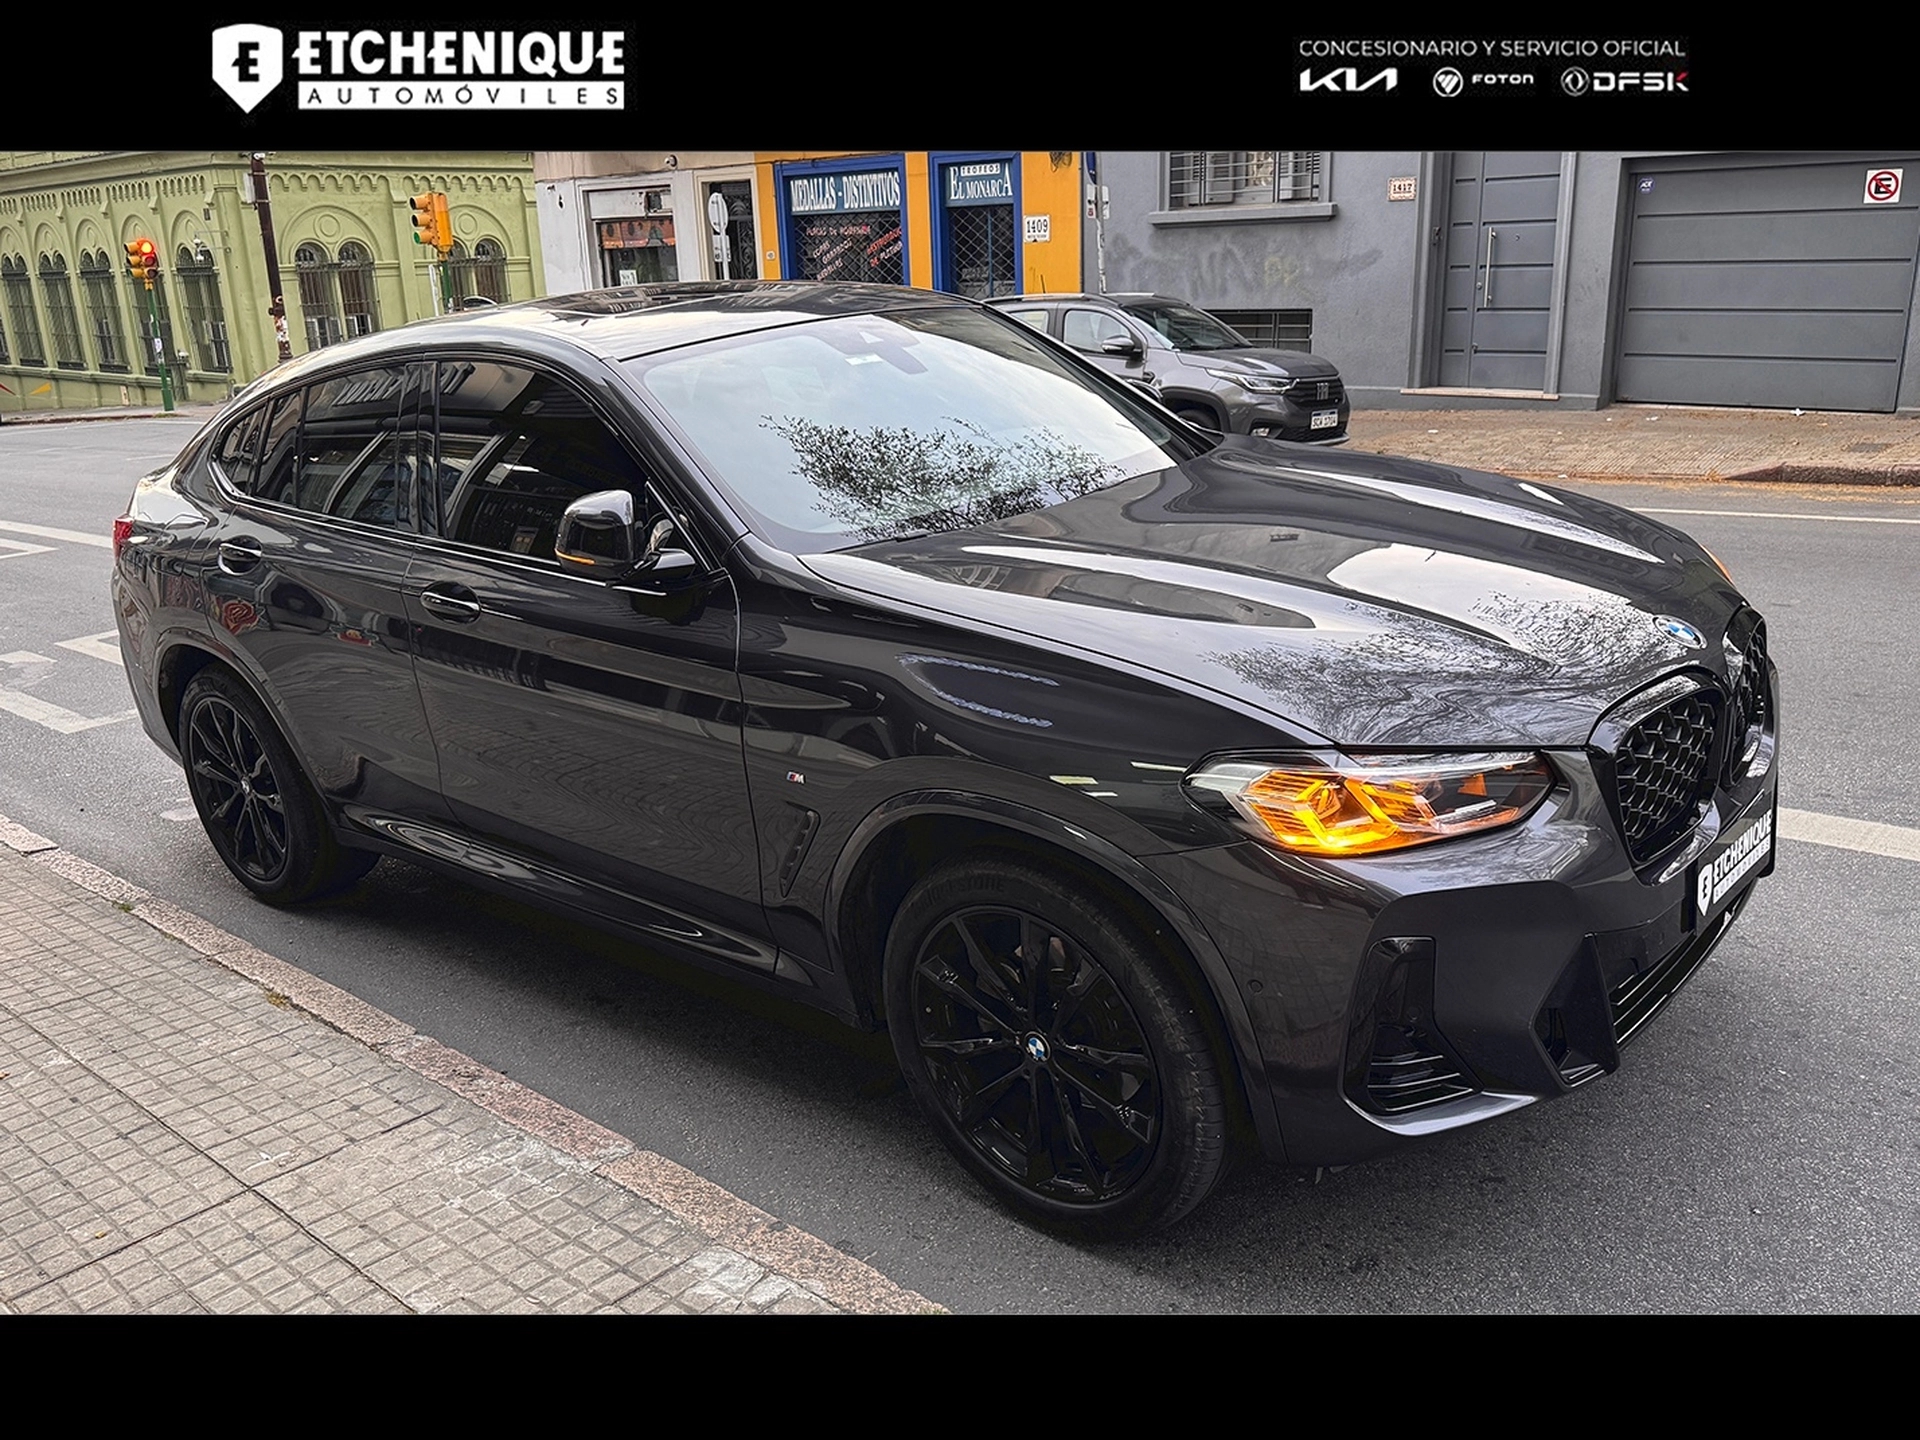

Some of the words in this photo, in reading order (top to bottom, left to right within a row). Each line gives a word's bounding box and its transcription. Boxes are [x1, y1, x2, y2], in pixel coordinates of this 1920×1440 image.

[790, 176, 837, 212] MEDALLAS
[842, 171, 900, 209] DISTINTIVOS
[1393, 183, 1413, 191] 1417
[1027, 219, 1049, 233] 1409
[1713, 809, 1772, 885] ETCHENIQUE
